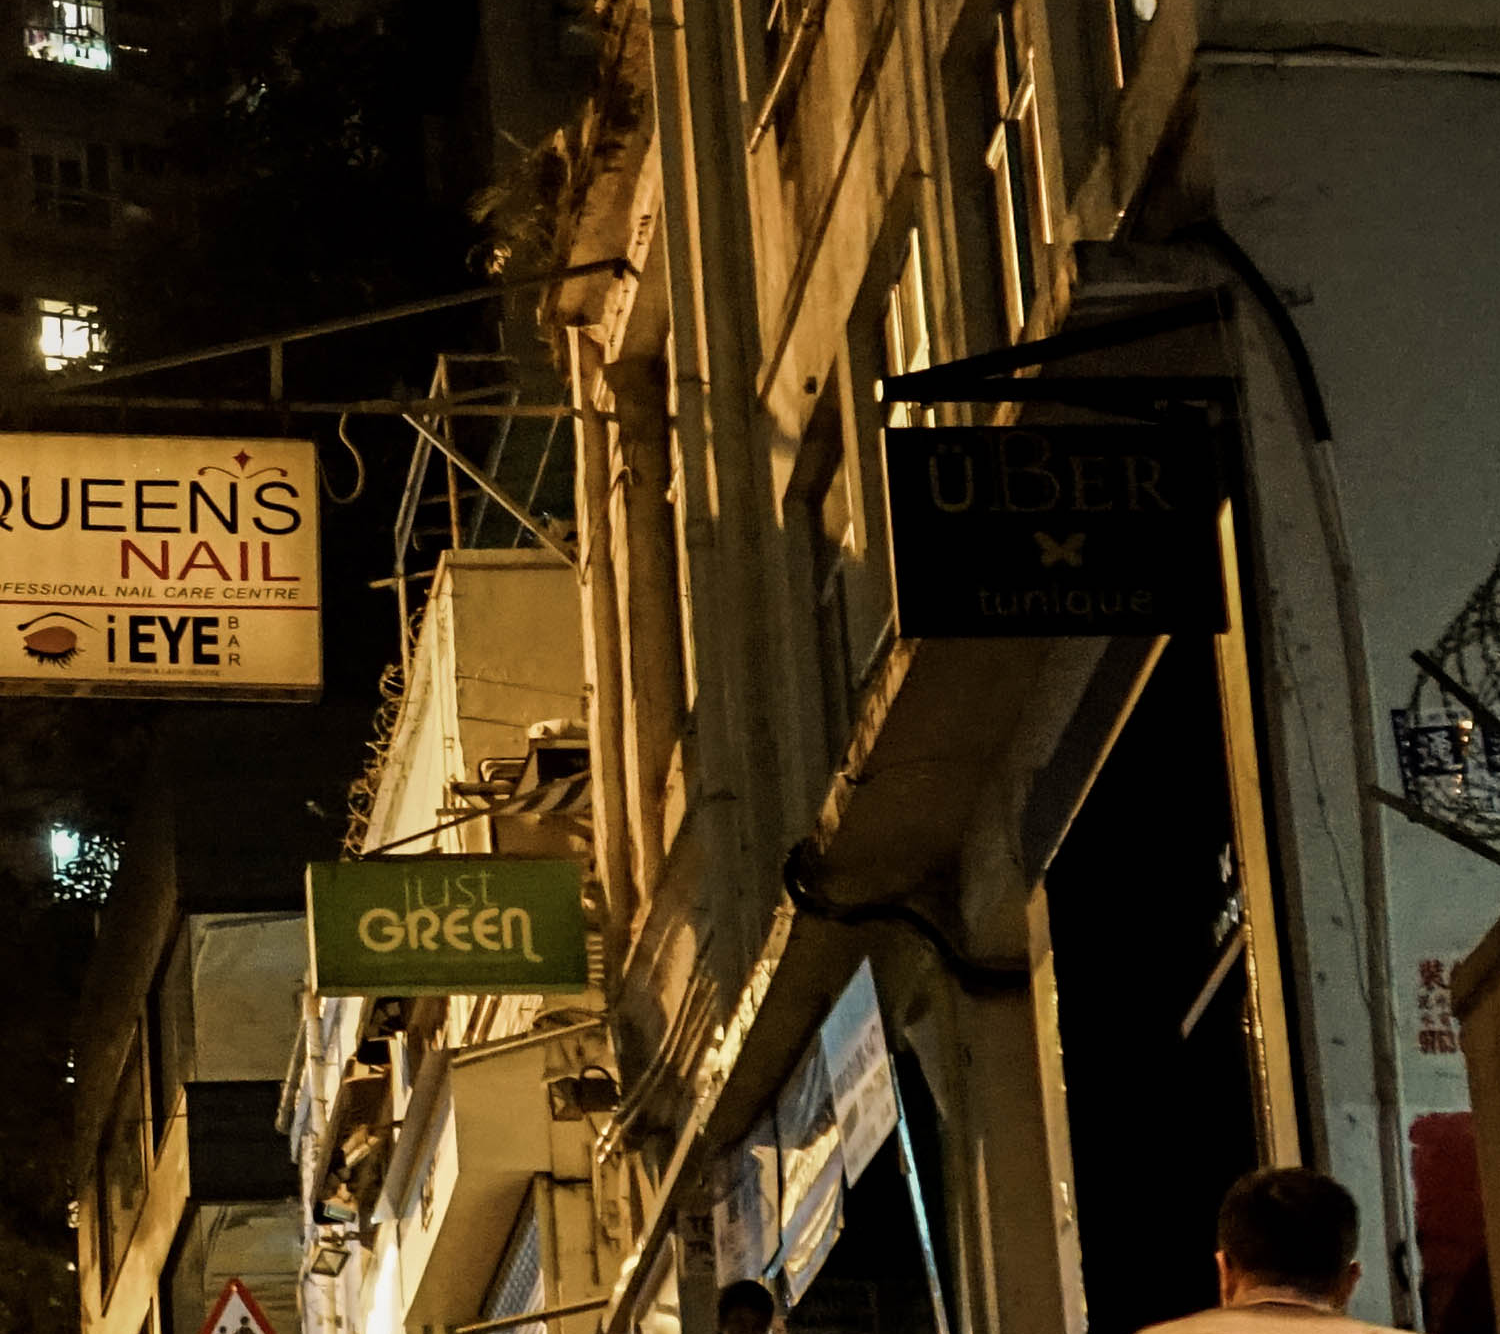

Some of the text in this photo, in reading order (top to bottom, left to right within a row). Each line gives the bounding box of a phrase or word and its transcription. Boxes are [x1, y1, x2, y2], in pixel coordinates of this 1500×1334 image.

[120, 539, 301, 582] NAIL
[115, 585, 156, 599] NAIL
[164, 586, 215, 600] CARE
[222, 587, 301, 601] CENTRE
[128, 615, 220, 665] EYE
[228, 616, 241, 666] BAR
